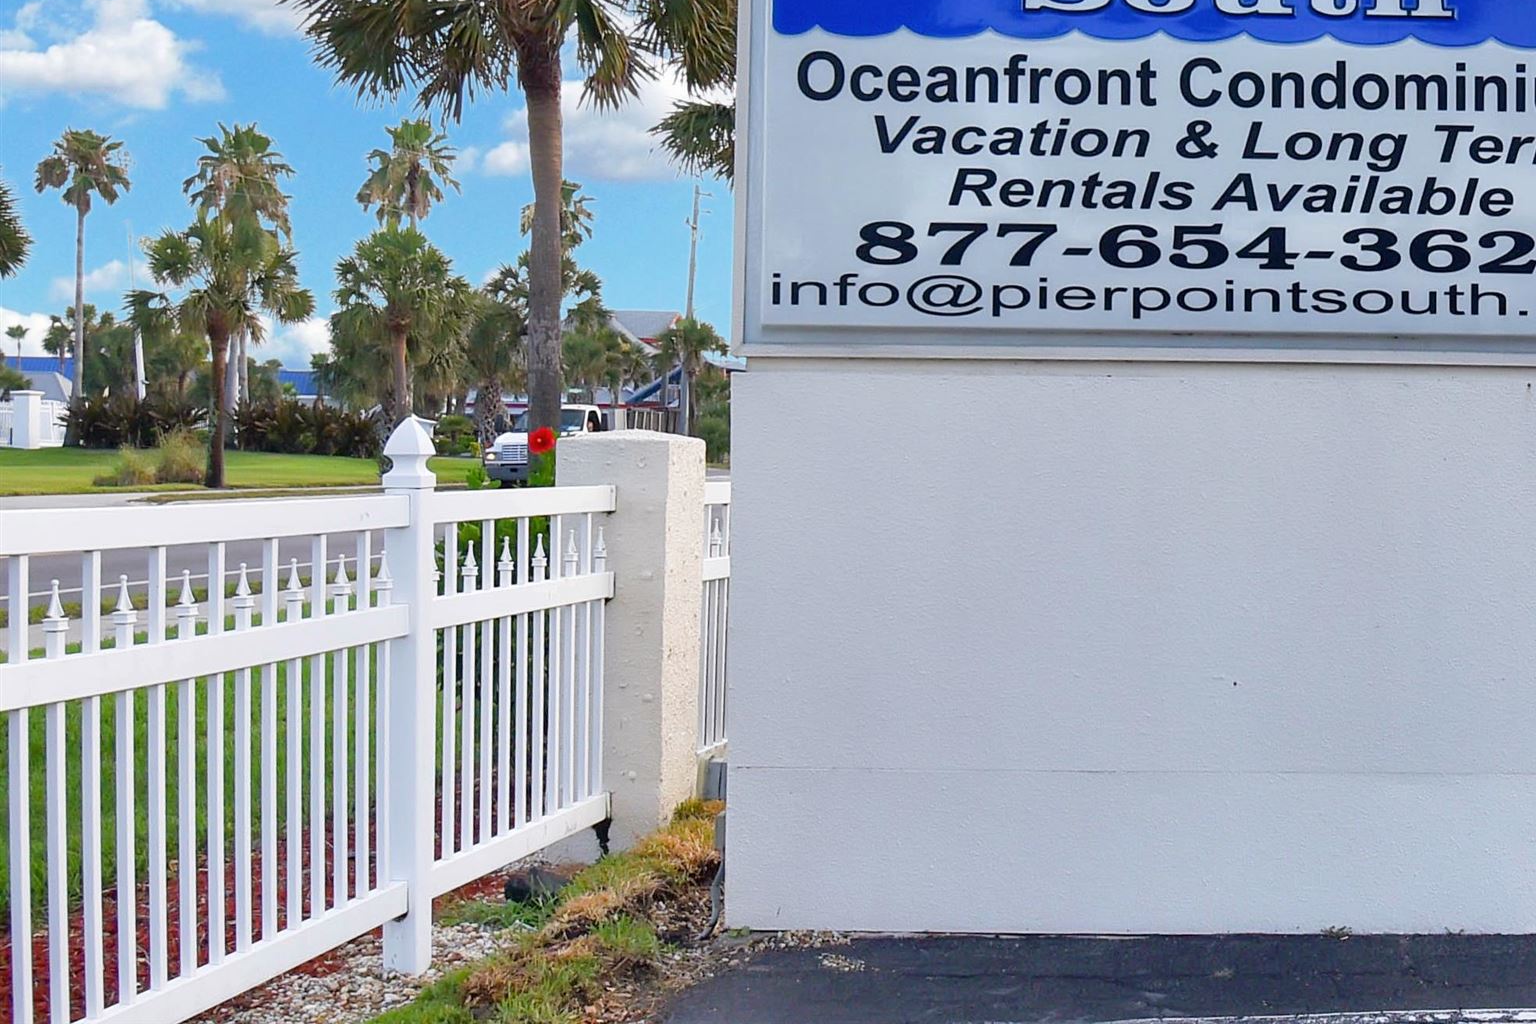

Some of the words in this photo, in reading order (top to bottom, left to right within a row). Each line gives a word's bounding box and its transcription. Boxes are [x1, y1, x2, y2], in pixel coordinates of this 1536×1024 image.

[797, 50, 1157, 107] Oceanfront
[874, 115, 1150, 158] Vacation
[1175, 119, 1219, 160] &
[1241, 121, 1408, 173] Long
[948, 167, 1195, 212] Rentals
[1211, 172, 1514, 217] Available
